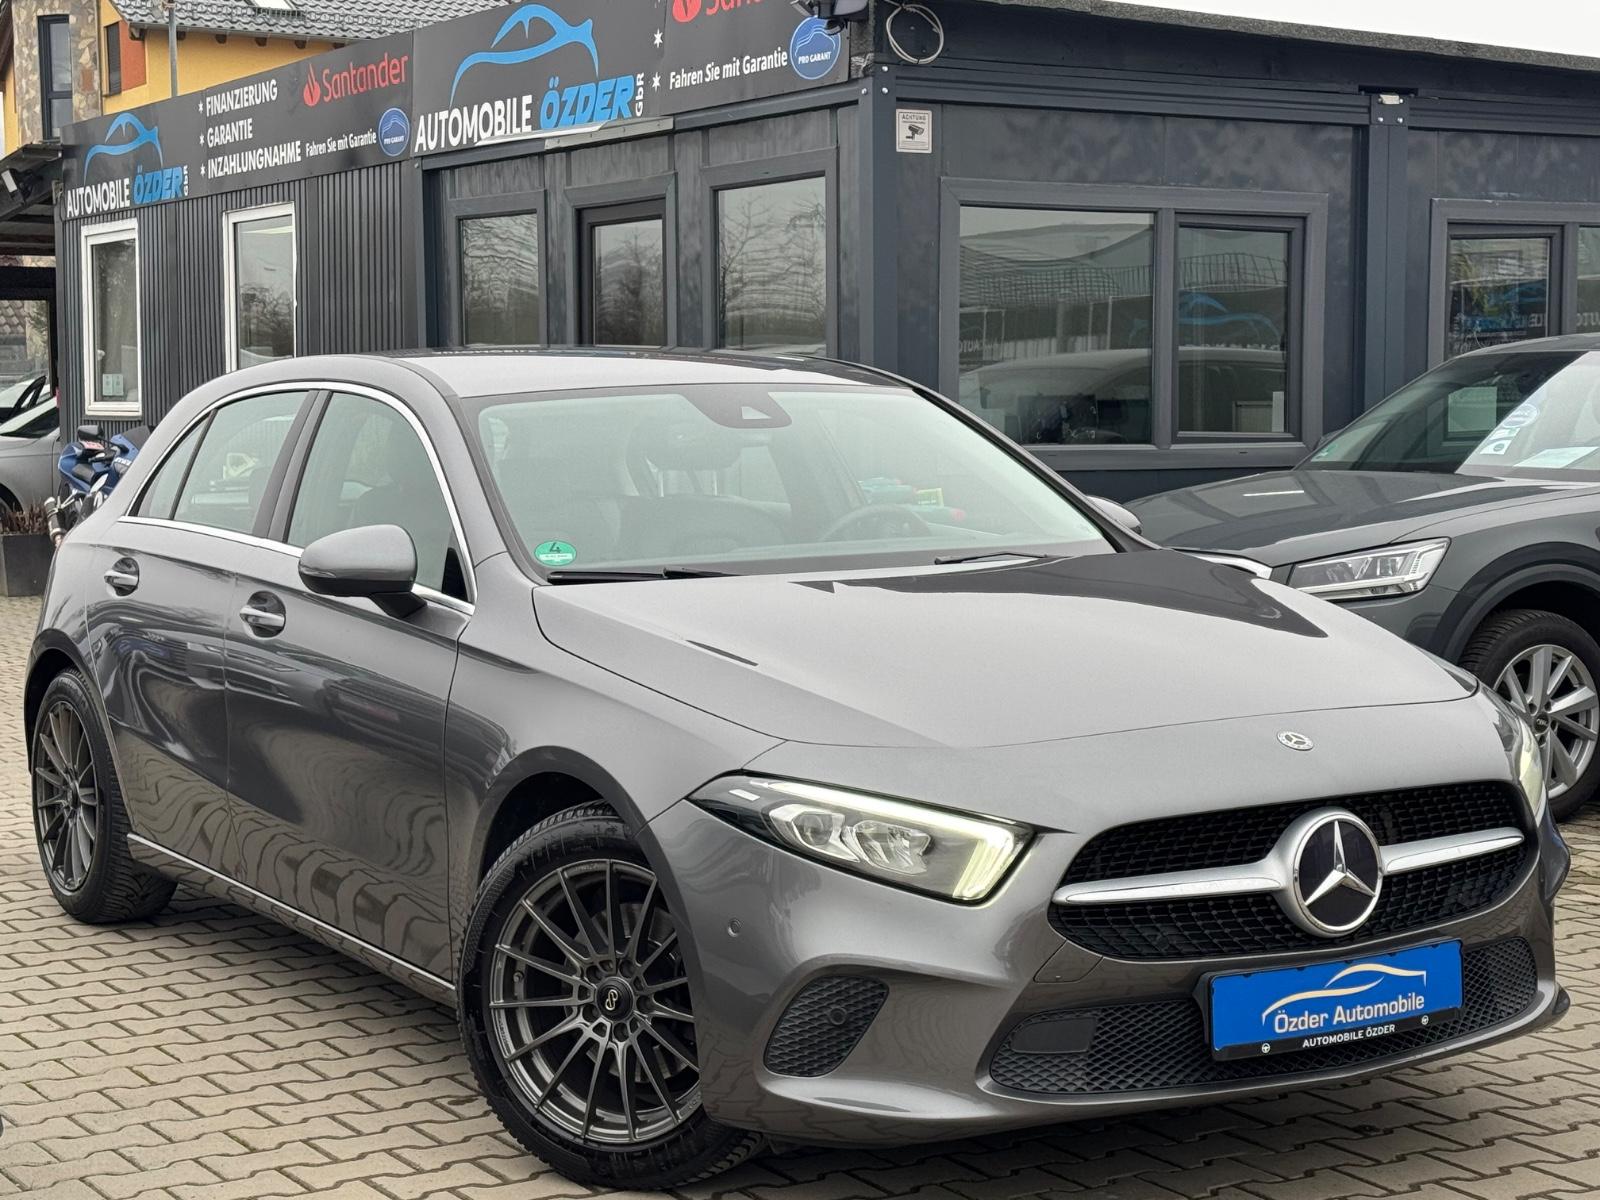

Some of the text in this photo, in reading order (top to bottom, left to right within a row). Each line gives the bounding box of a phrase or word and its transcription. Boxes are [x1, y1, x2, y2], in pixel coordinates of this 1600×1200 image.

[322, 52, 409, 102] Santander
[669, 47, 788, 90] Fahren Sie mit Garantie
[798, 52, 832, 65] PRO GARANT
[206, 79, 278, 117] FINANZIERUNG
[414, 72, 645, 152] AUTOMOBILE ÖZDER GbR
[207, 118, 253, 148] GARANTIE
[305, 128, 377, 158] Fahren Sie mit Garantie
[207, 141, 302, 179] INZAHLUNGNAHME
[66, 178, 130, 218] AUTOMOBILE
[133, 164, 183, 205] ÖZDER
[1274, 992, 1425, 1034] Özder Automobile
[1302, 1024, 1395, 1049] AUTOMOBILE ÖZDER
